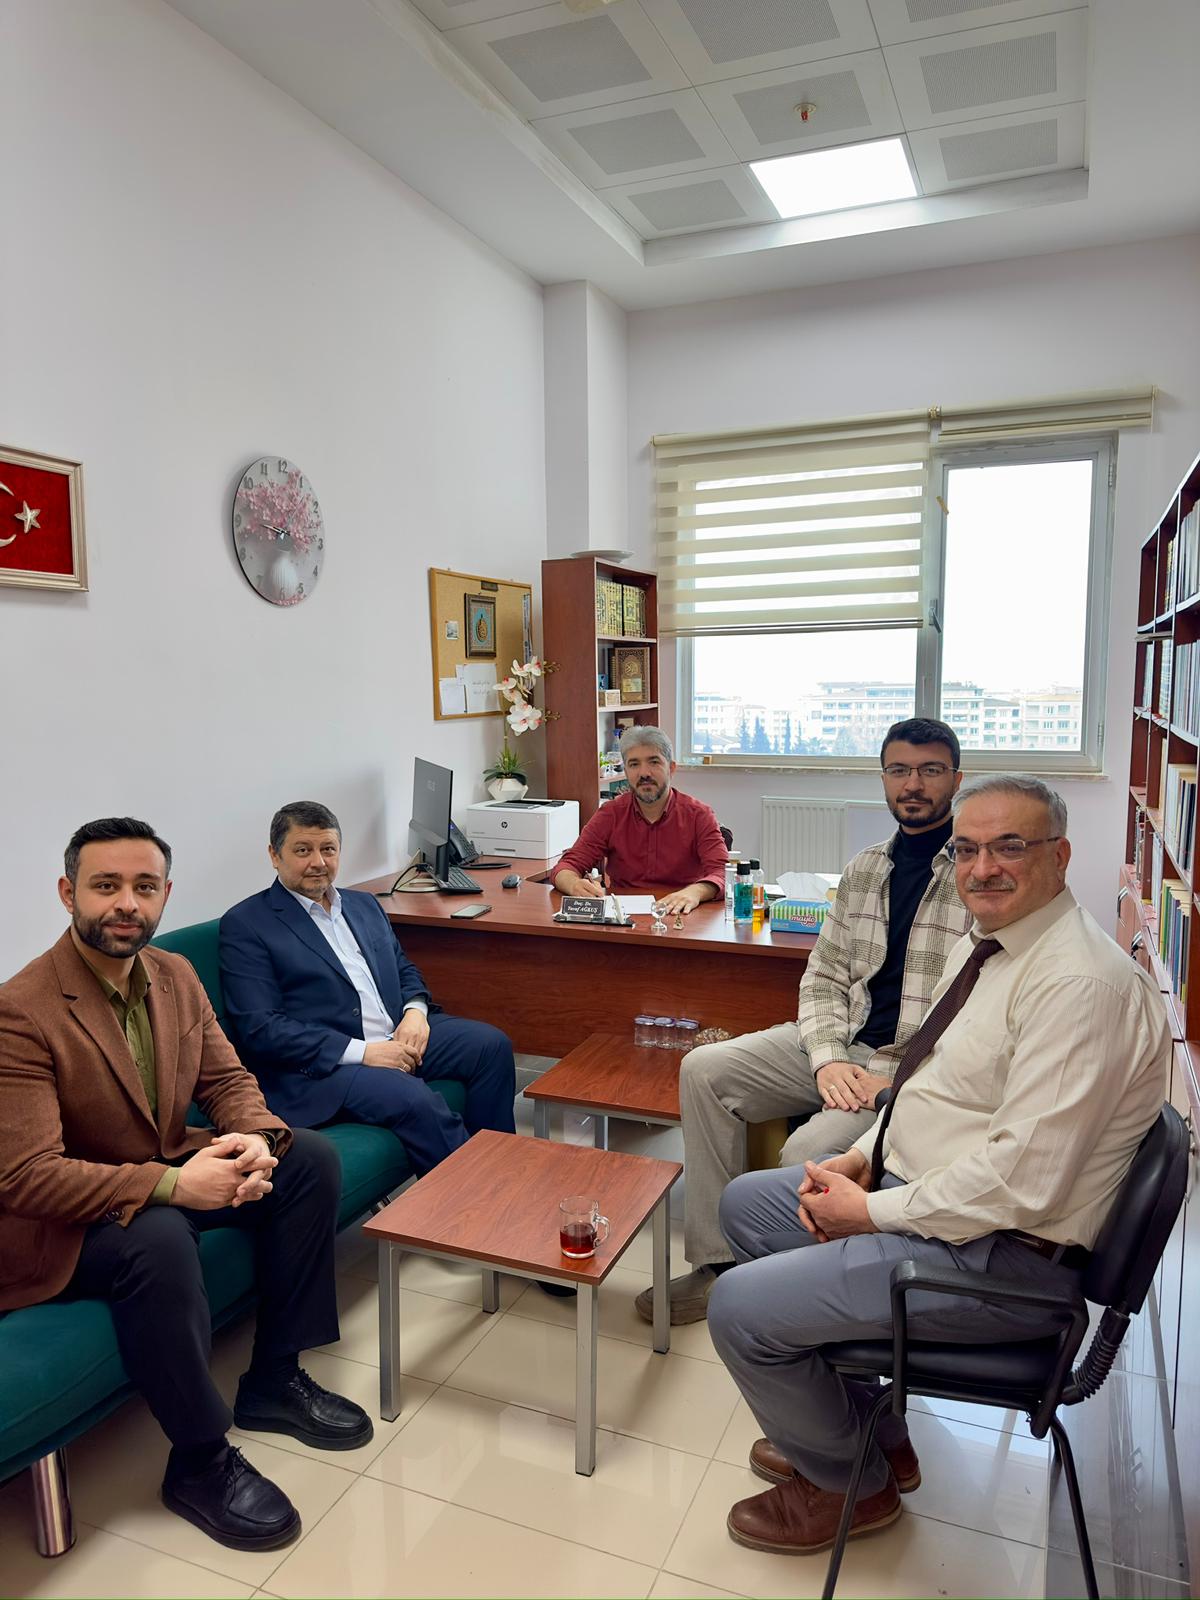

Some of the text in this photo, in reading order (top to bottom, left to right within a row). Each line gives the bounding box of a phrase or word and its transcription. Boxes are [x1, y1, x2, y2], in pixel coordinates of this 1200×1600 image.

[260, 462, 268, 476] 11
[278, 459, 288, 474] 12
[243, 476, 254, 490] 10
[313, 501, 319, 514] 2
[234, 514, 242, 527] 9
[318, 538, 324, 550] 3
[312, 565, 318, 577] 4
[298, 582, 304, 594] 5
